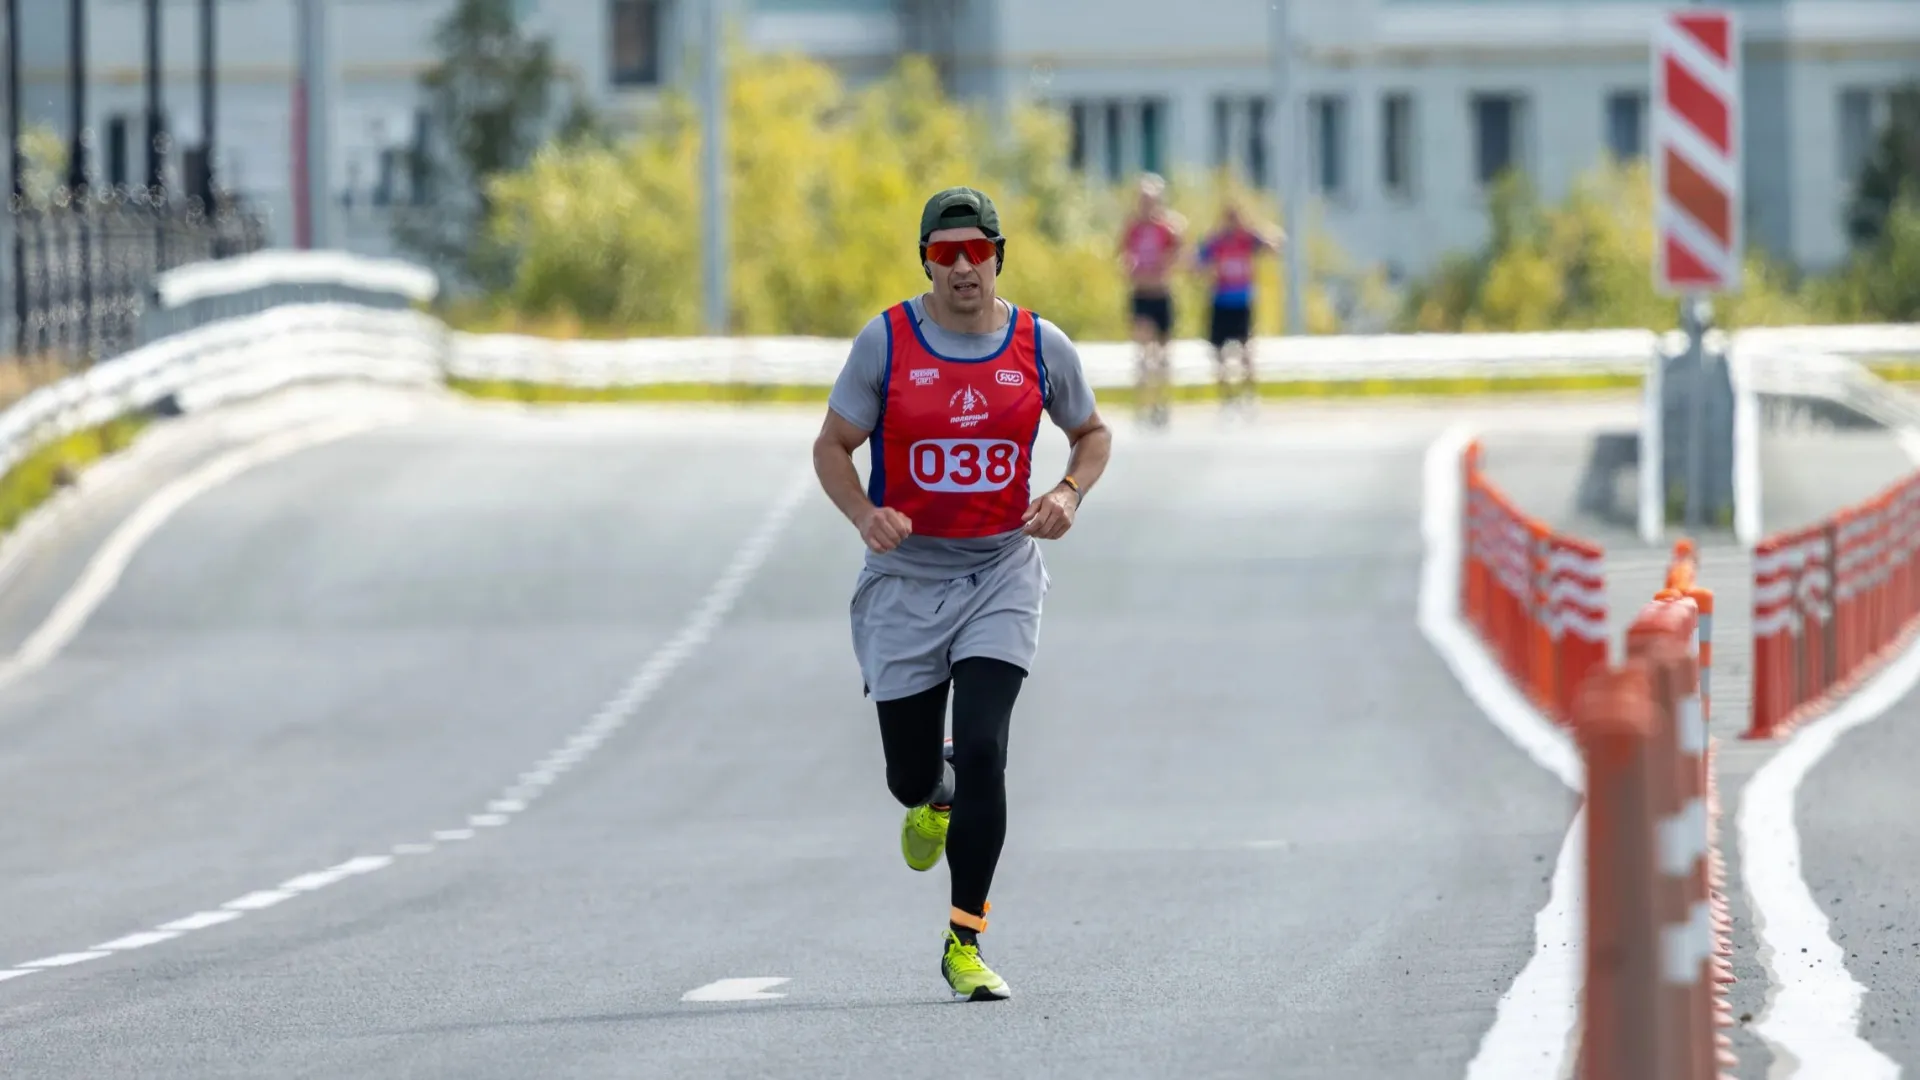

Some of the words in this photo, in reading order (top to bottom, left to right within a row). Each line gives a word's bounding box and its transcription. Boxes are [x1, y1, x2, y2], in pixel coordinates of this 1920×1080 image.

[950, 412, 989, 423] ПОЛЯРНЫЙ
[960, 420, 979, 428] КРУГ
[914, 443, 1014, 486] 038
